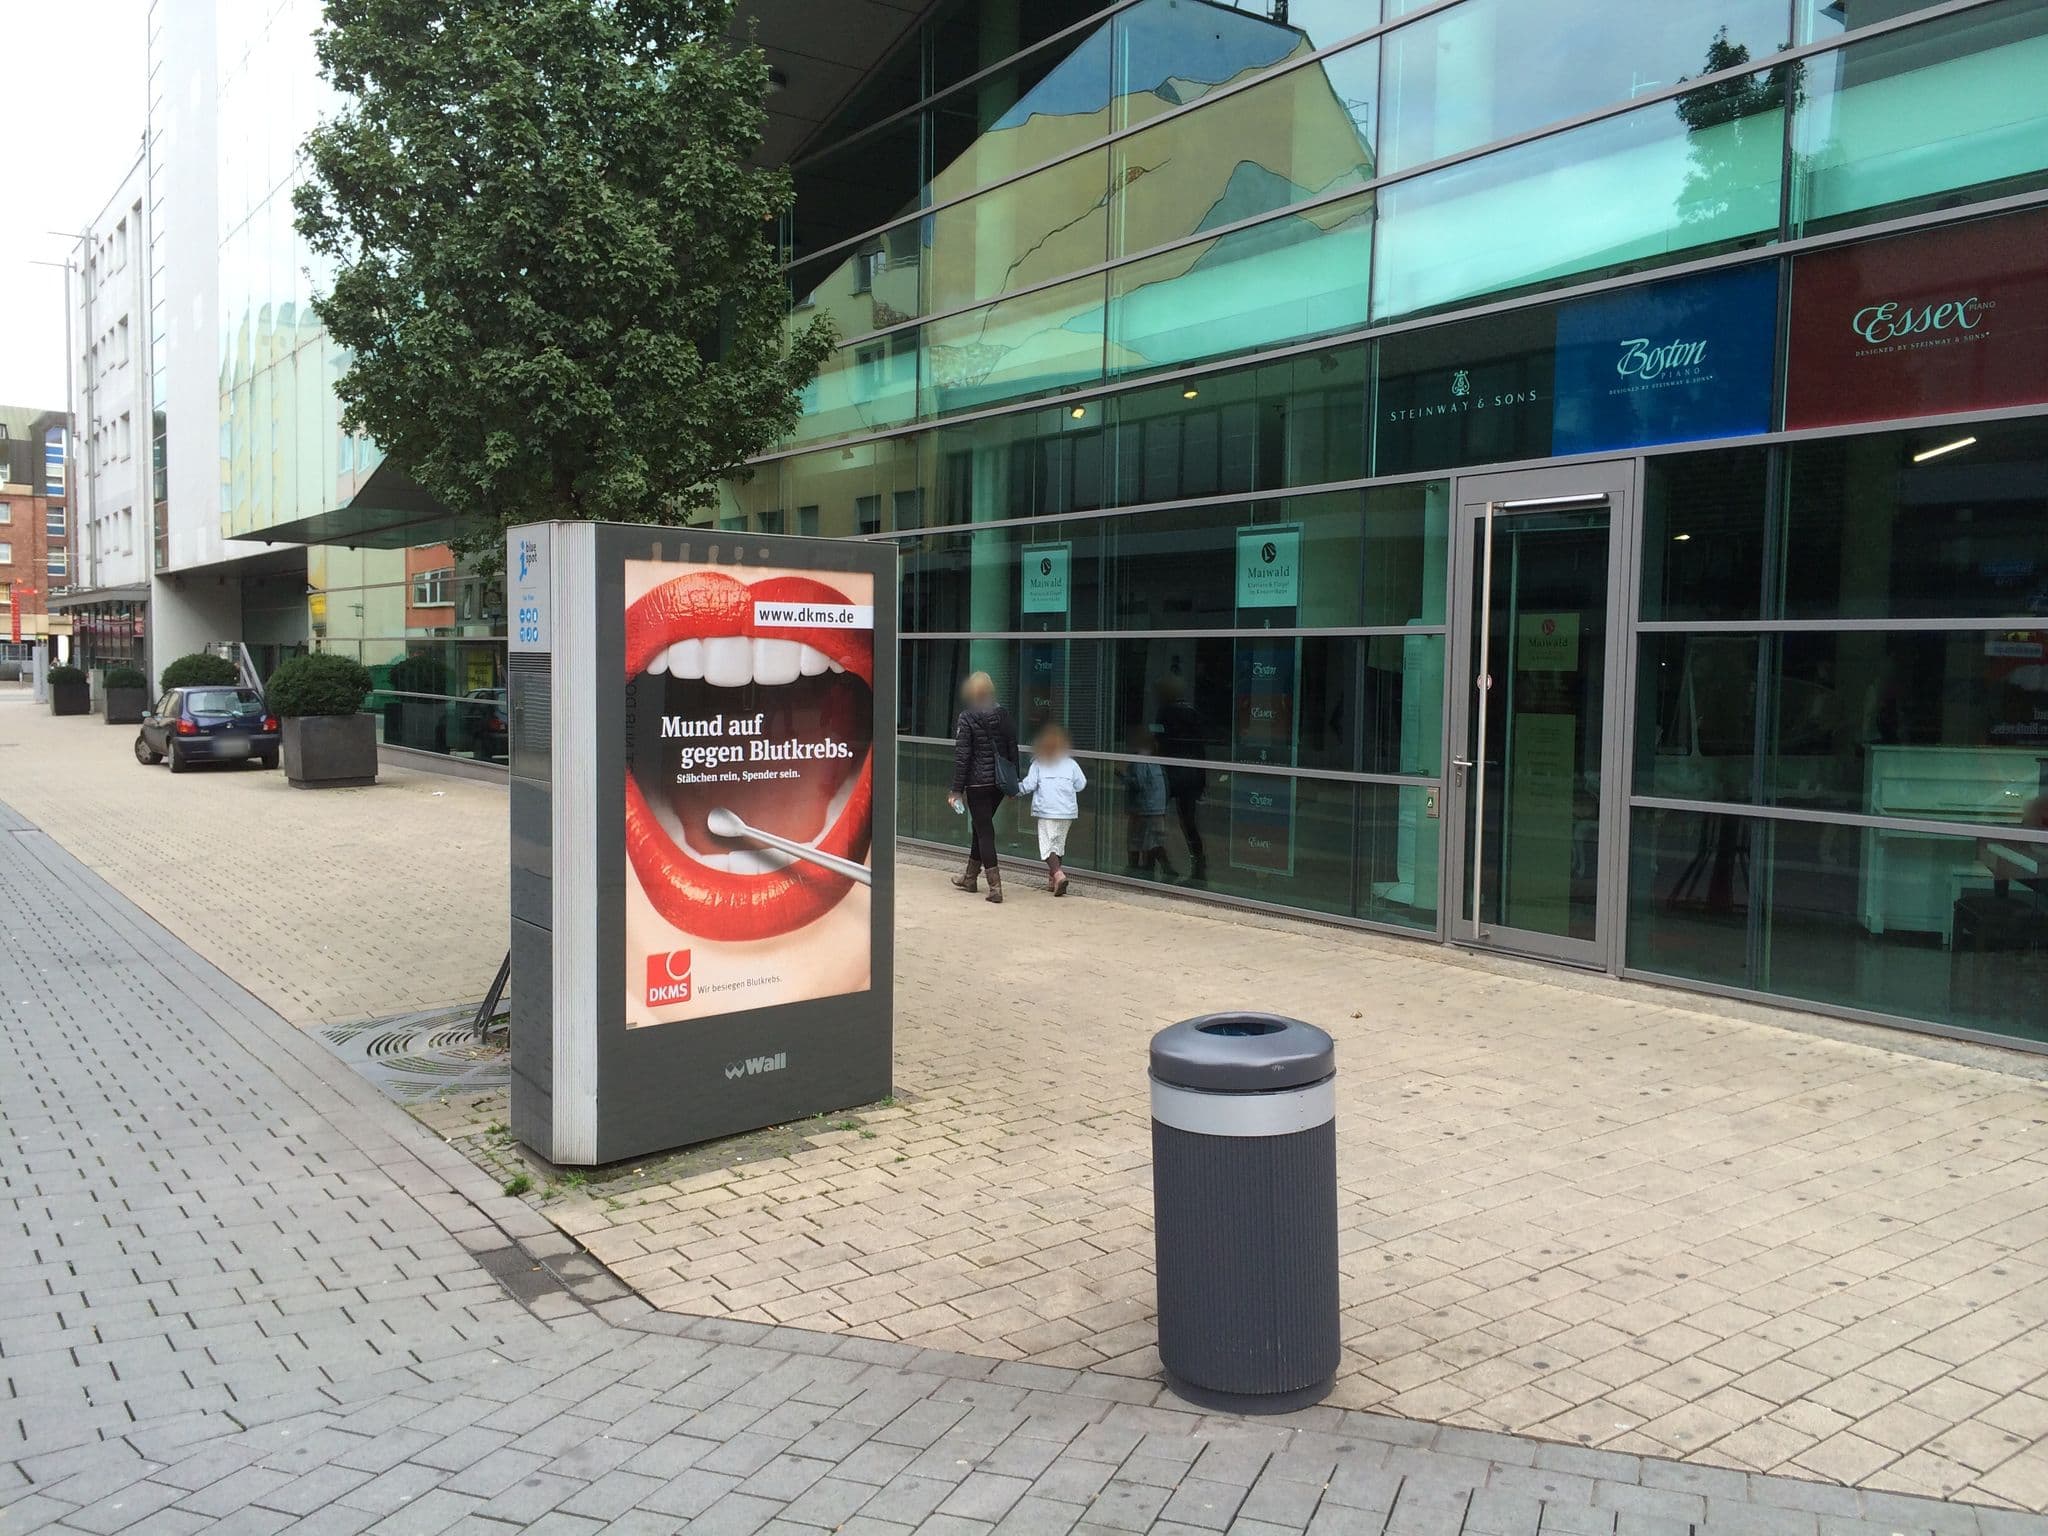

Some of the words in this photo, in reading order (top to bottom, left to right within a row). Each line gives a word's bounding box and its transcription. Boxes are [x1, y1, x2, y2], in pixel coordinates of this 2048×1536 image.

[1969, 300, 1996, 311] PIANO
[1852, 297, 1982, 344] Essex
[1855, 346, 1894, 358] DESIGNED
[1910, 337, 1952, 350] STEINWAY
[1617, 338, 1707, 380] Boston
[1661, 367, 1700, 380] PIANO
[1390, 401, 1469, 422] STEINWAY
[1477, 397, 1485, 409] &
[1494, 389, 1537, 407] SONS
[525, 540, 537, 553] blue
[526, 554, 538, 567] spot
[1248, 566, 1290, 579] Maiwald
[759, 607, 854, 624] www.dkms.de
[660, 714, 723, 738] Mund
[728, 713, 765, 736] auf
[681, 743, 745, 769] gegen
[749, 738, 854, 763] Blutkrebs.
[676, 771, 718, 784] Stäbchen
[719, 771, 741, 783] rein,
[742, 769, 778, 782] Spender
[779, 768, 801, 779] sein.
[649, 982, 688, 1002] DKMS
[697, 983, 710, 995] Wir
[711, 980, 745, 993] besiegen
[746, 975, 784, 987] Blutkrebs.
[745, 1052, 787, 1076] Wall
